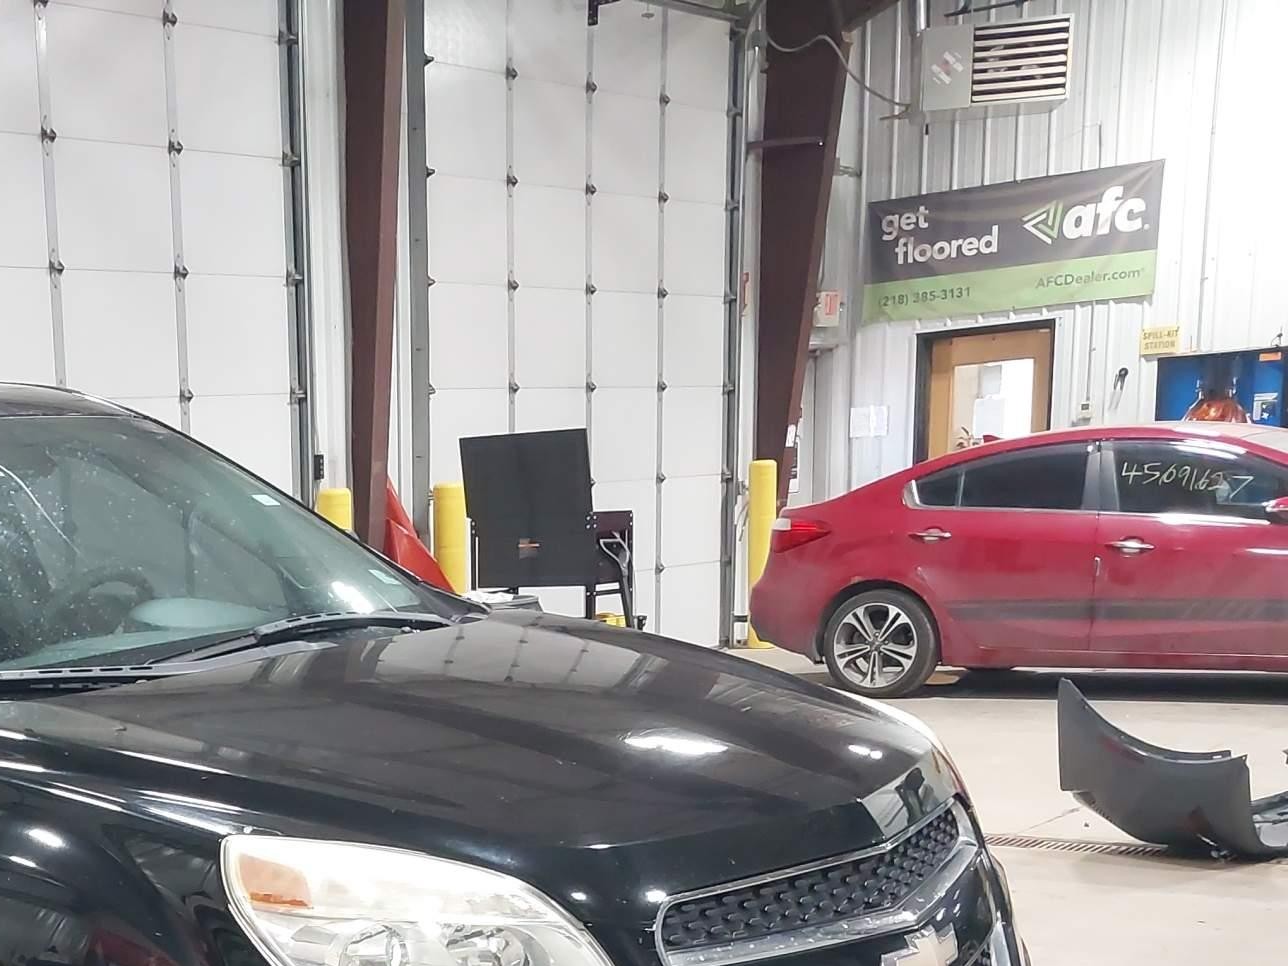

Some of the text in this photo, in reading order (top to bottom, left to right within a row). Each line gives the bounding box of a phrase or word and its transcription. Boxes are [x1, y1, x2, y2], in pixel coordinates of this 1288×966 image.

[881, 205, 929, 241] get
[894, 224, 999, 265] floored
[1035, 268, 1141, 289] AFCDealer.com
[878, 286, 971, 307] (218) 385-3131
[1143, 330, 1178, 340] SPILL-KIT
[1144, 340, 1176, 350] STATION
